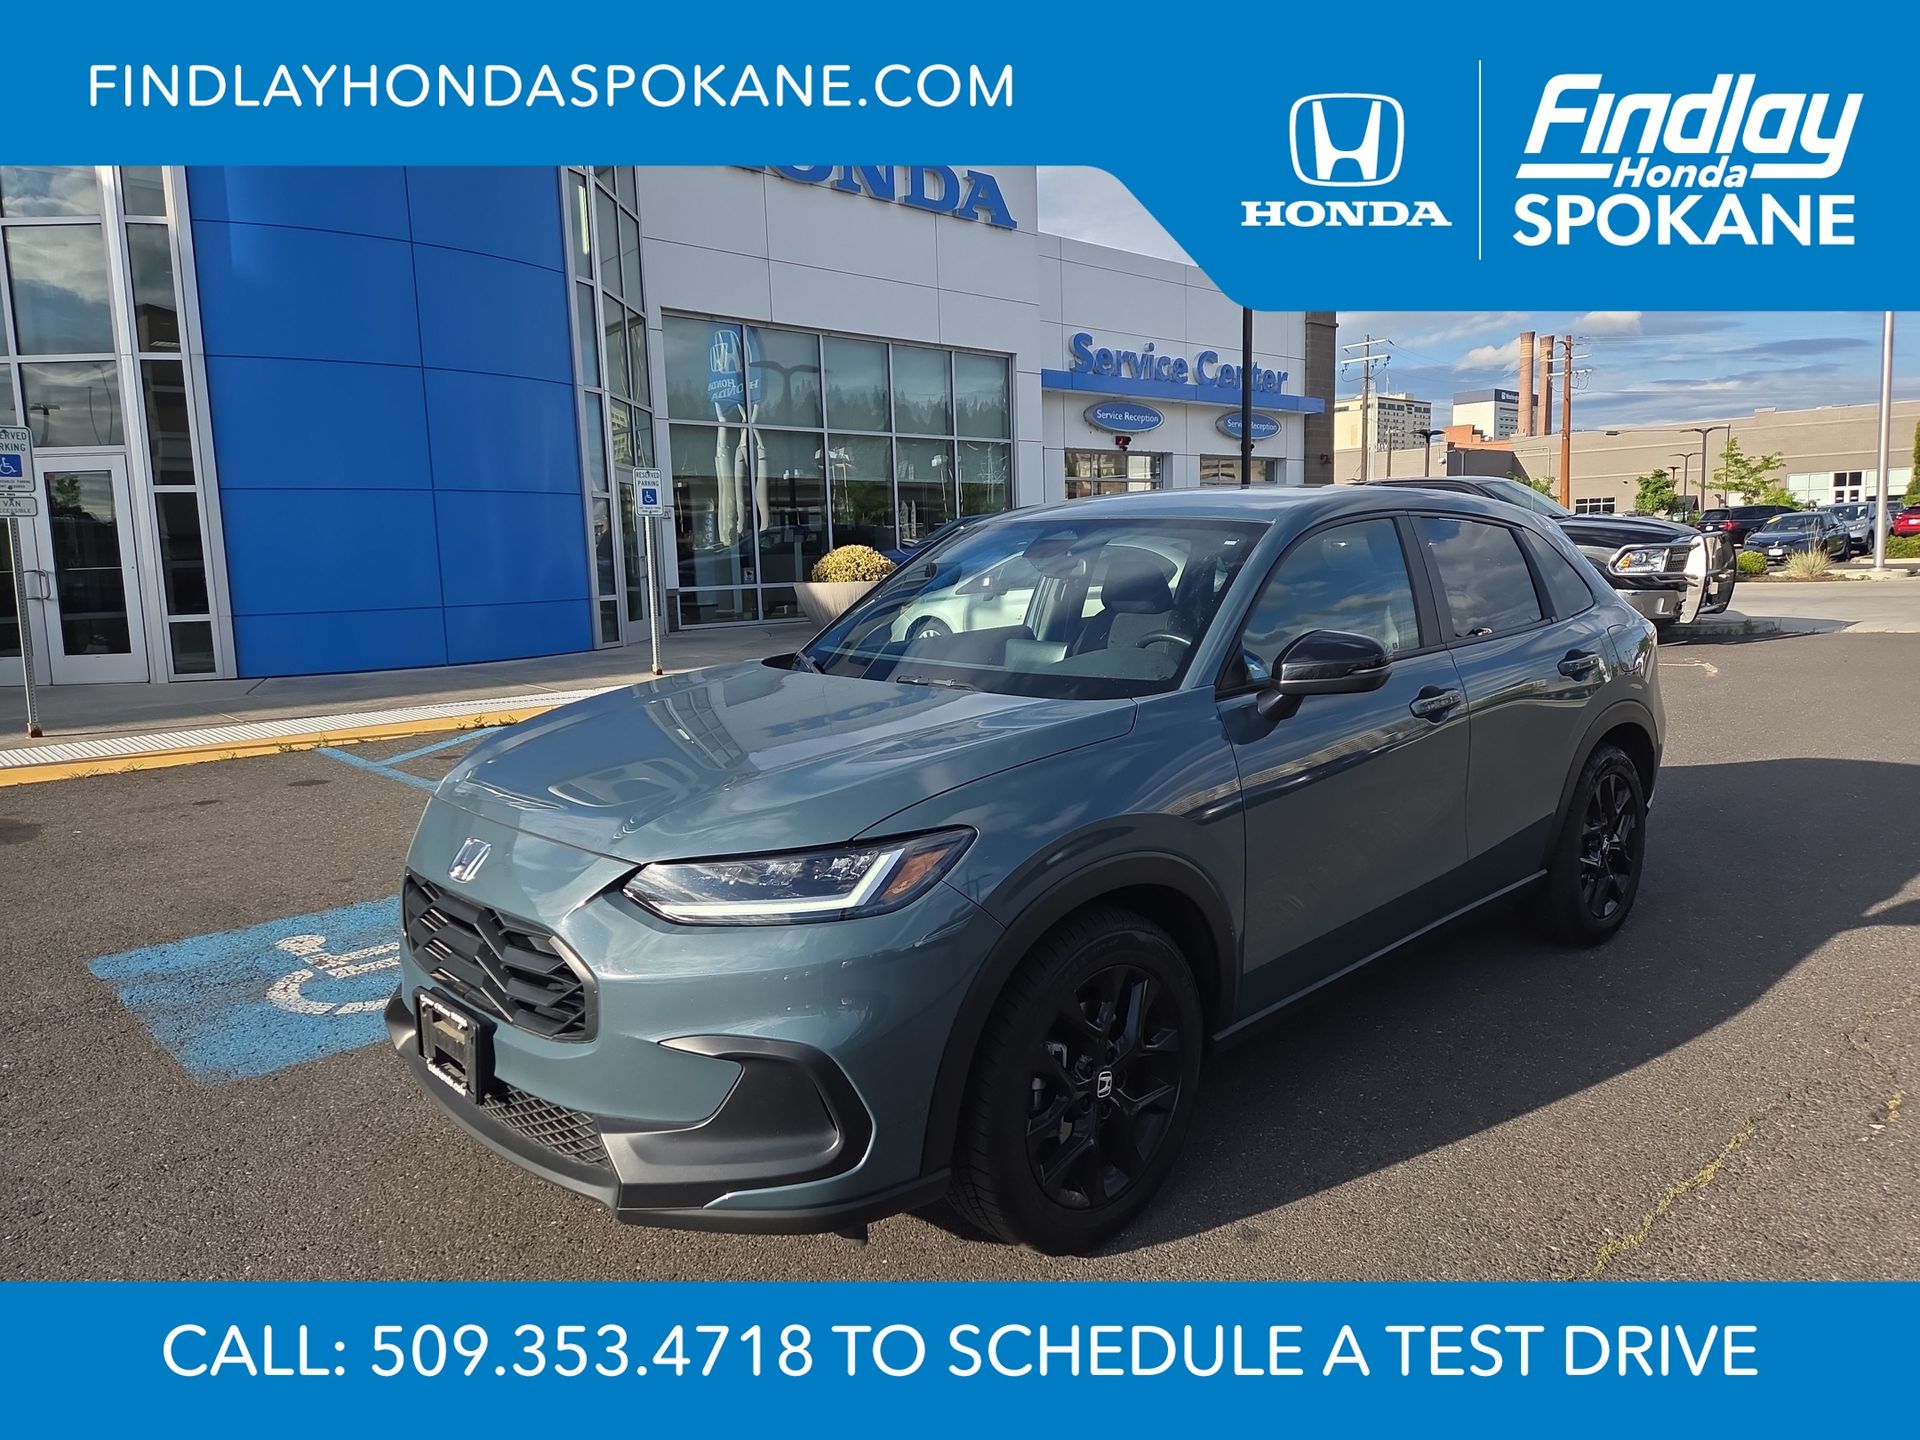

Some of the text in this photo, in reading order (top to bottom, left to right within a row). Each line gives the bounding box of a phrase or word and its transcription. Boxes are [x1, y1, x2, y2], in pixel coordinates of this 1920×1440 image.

[1069, 332, 1188, 384] Service
[1096, 409, 1159, 424] Service Reception
